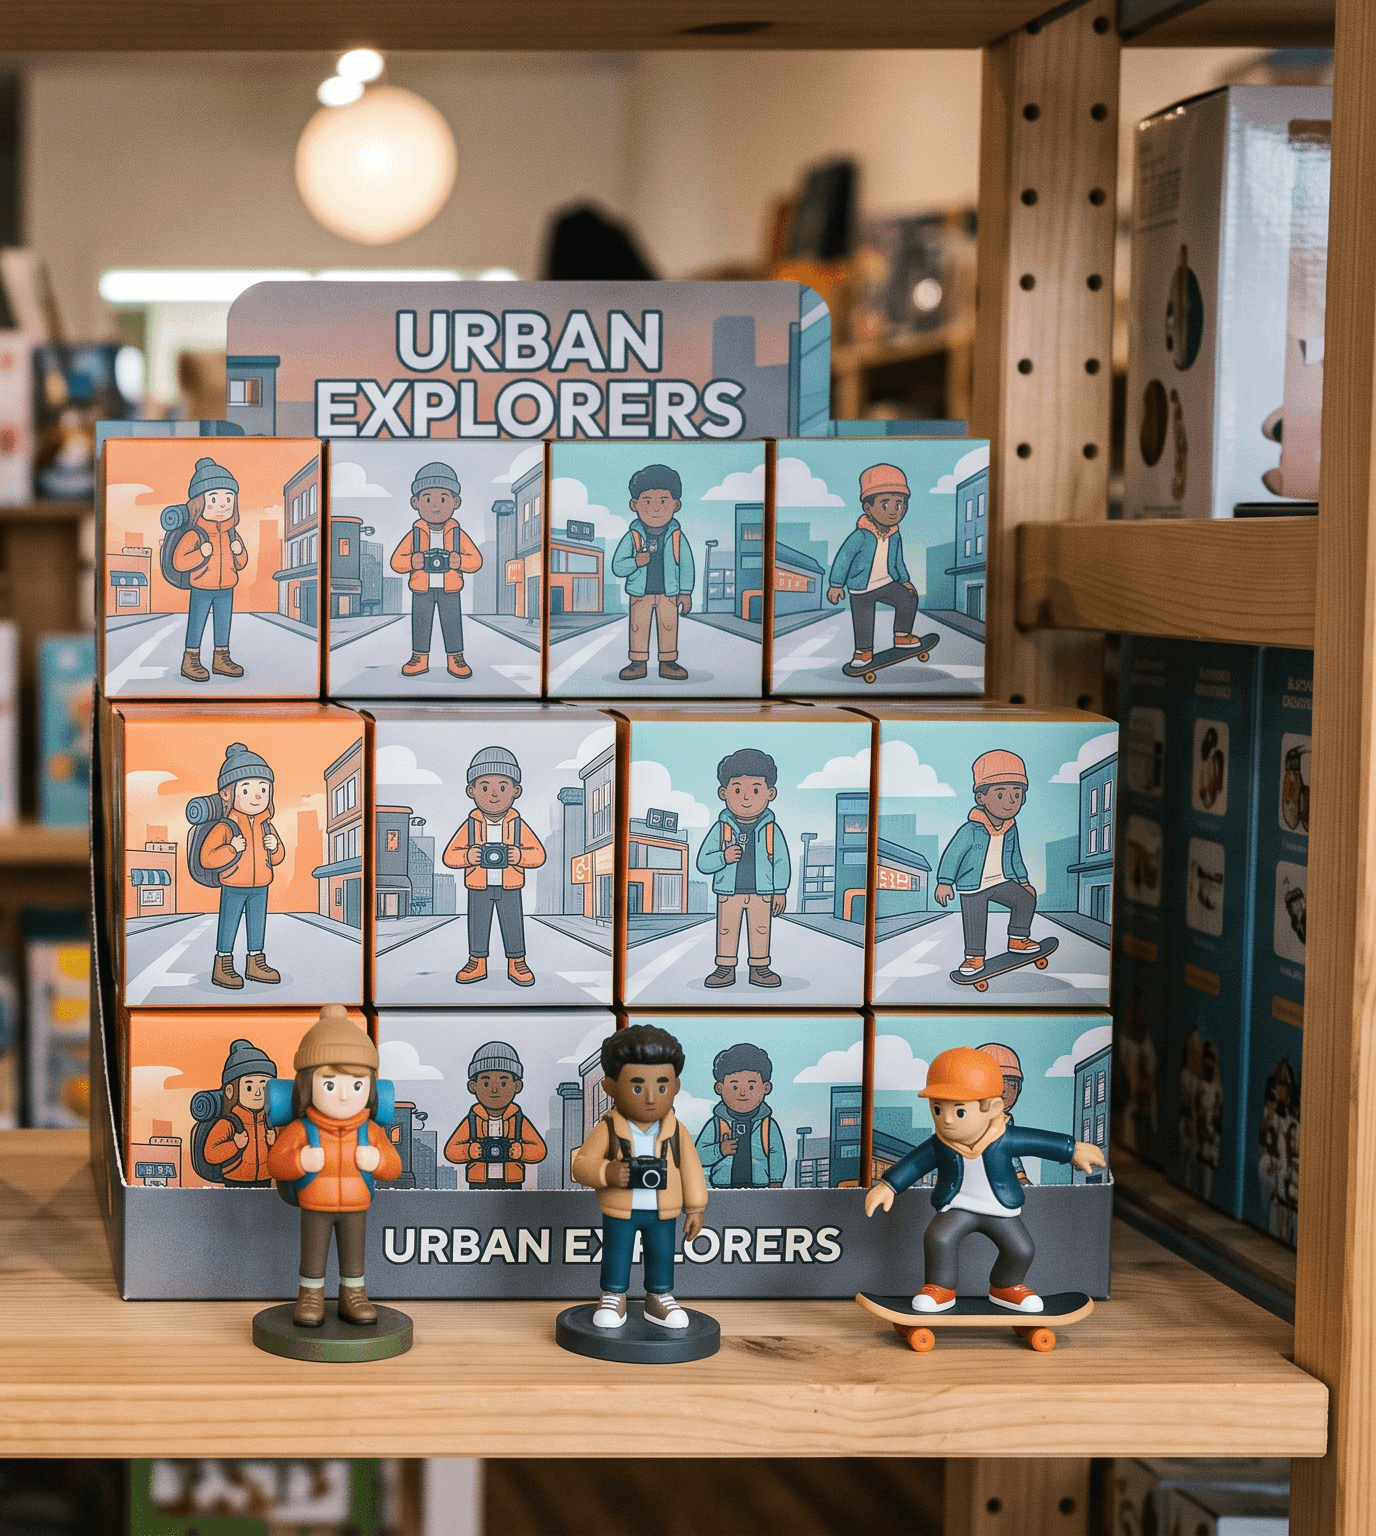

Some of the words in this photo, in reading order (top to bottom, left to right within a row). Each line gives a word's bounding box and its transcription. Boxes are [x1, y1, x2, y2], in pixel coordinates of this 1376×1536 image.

[397, 311, 661, 372] URBAN
[316, 380, 744, 438] EXPLORERS
[384, 1227, 550, 1263] URBAN
[564, 1226, 842, 1263] EORERS
